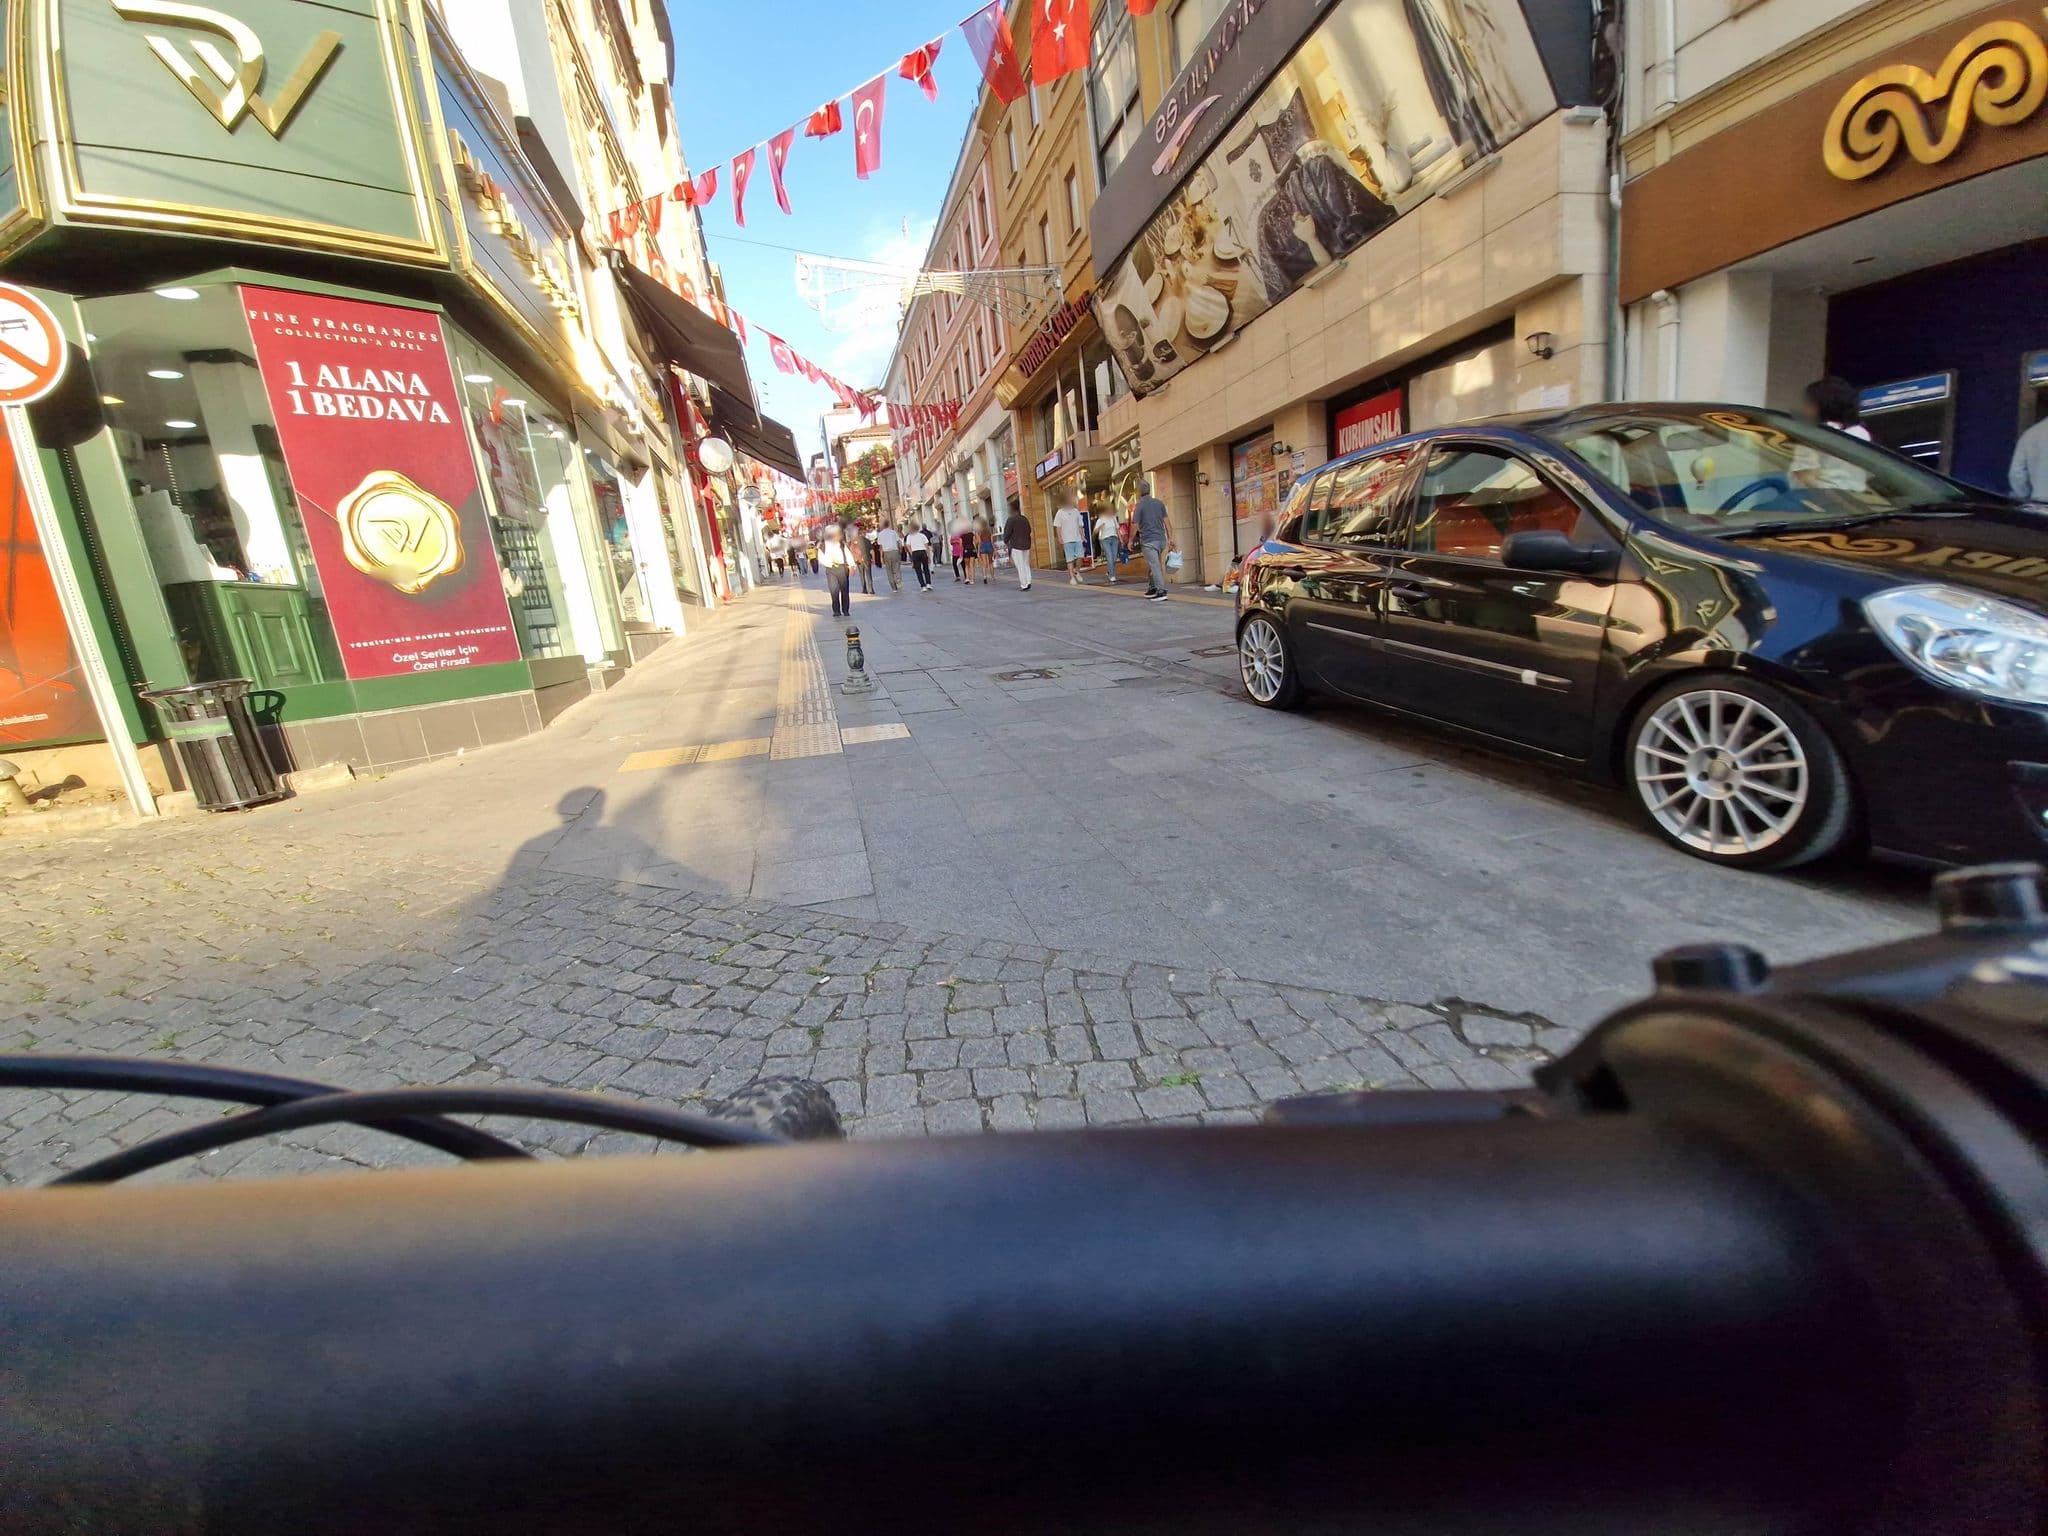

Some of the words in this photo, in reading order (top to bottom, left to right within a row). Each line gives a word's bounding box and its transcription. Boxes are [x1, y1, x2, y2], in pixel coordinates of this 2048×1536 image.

[249, 310, 300, 325] FINE
[313, 317, 438, 342] FRAGRANCES
[275, 327, 383, 347] COLLECTION'A
[390, 341, 424, 352] ÖZEL
[285, 361, 309, 387] 1
[316, 364, 431, 396] ALANA
[286, 389, 309, 415] 1
[310, 391, 451, 424] BEDAVA
[392, 653, 419, 664] Özel
[421, 648, 456, 660] Seriler
[459, 645, 479, 657] İçin
[413, 661, 438, 671] Özel
[441, 656, 470, 669] Fırsat
